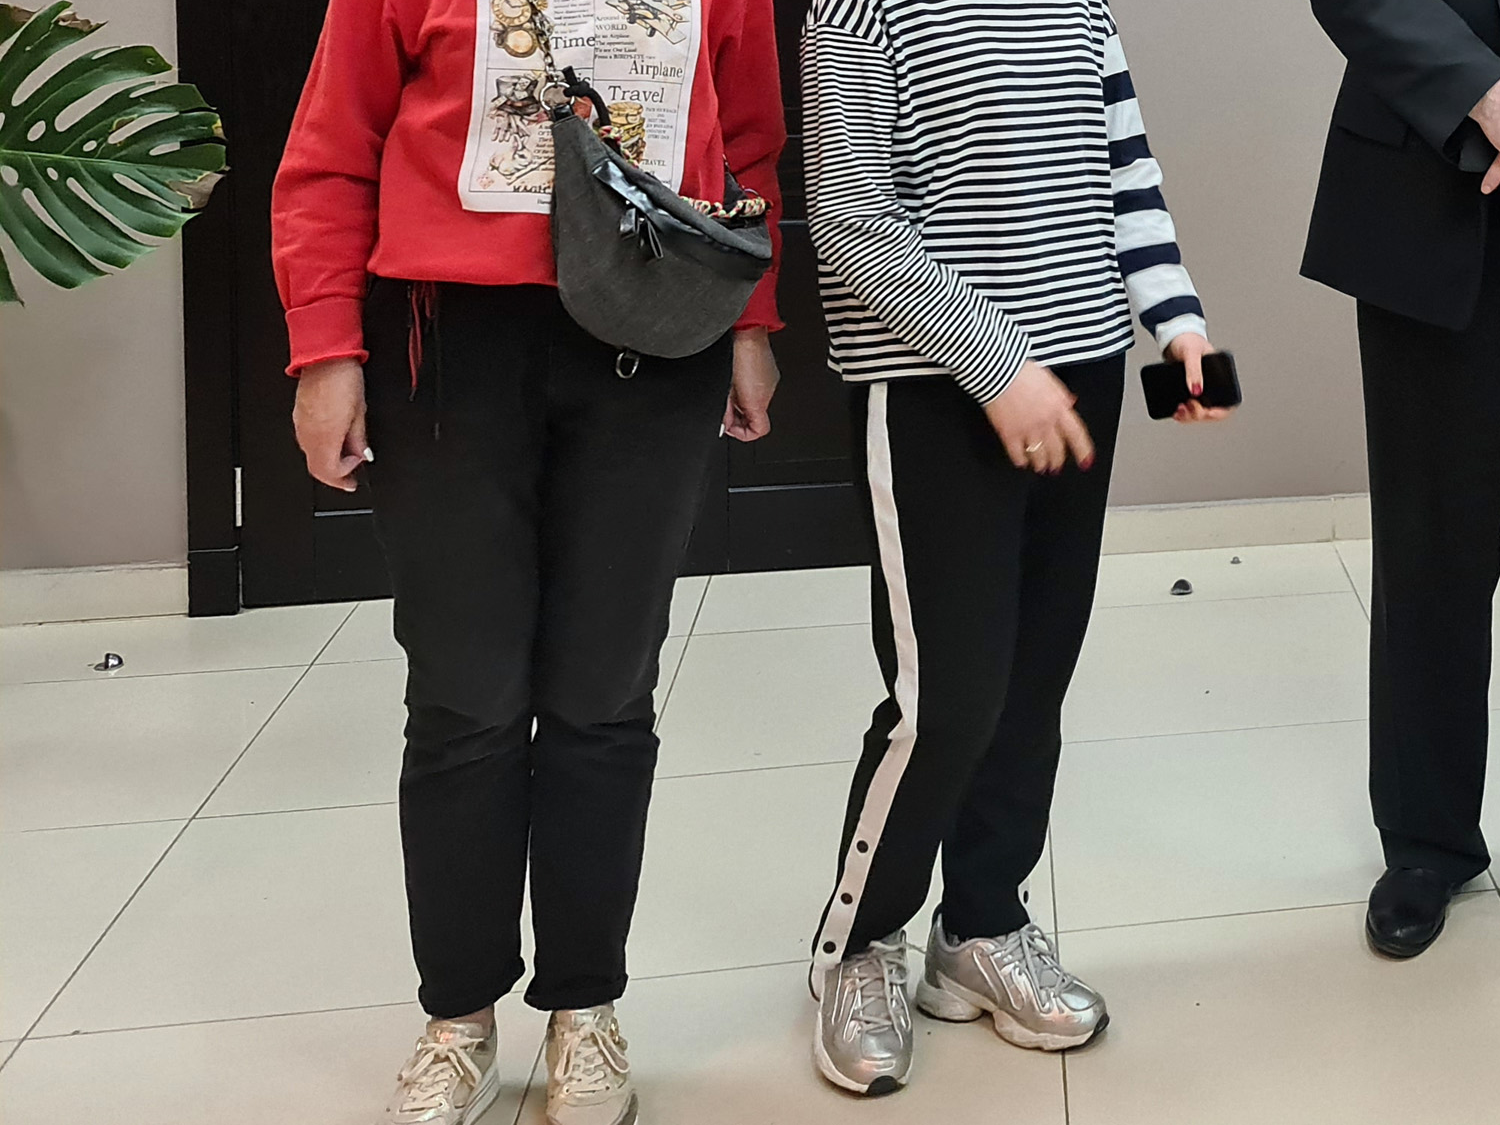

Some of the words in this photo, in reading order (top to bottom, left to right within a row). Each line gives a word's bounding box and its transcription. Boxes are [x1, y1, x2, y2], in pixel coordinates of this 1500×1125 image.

[550, 36, 596, 50] Time
[628, 59, 683, 79] Airplane
[608, 85, 665, 104] Travel
